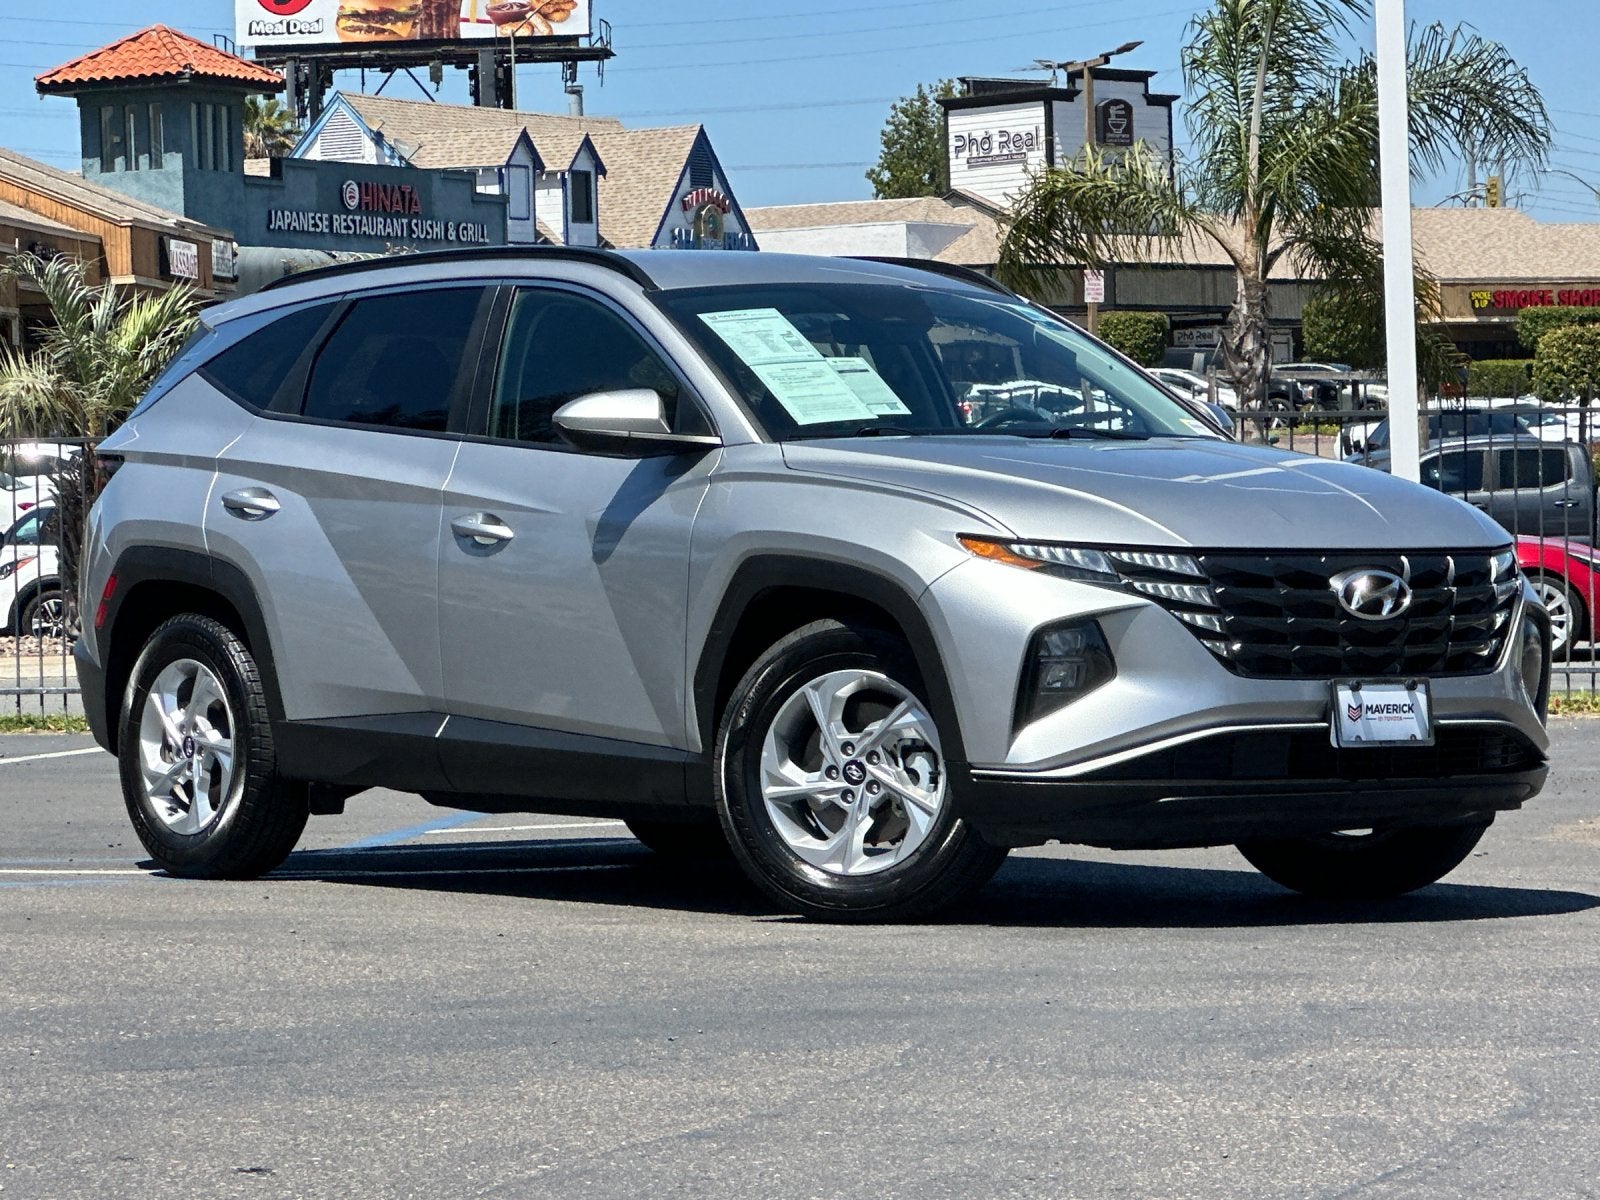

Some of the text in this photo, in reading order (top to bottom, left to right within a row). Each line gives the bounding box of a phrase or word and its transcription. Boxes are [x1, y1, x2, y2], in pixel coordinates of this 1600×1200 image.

[248, 18, 324, 36] Meal Deal
[998, 125, 1039, 151] Real
[360, 181, 422, 215] HINATA
[269, 209, 490, 243] JAPANESE RESTAURANT SUSHI & GRILL
[1471, 291, 1491, 300] SMOKE
[1493, 289, 1553, 309] SMOKE
[1366, 703, 1415, 714] MAVERICK
